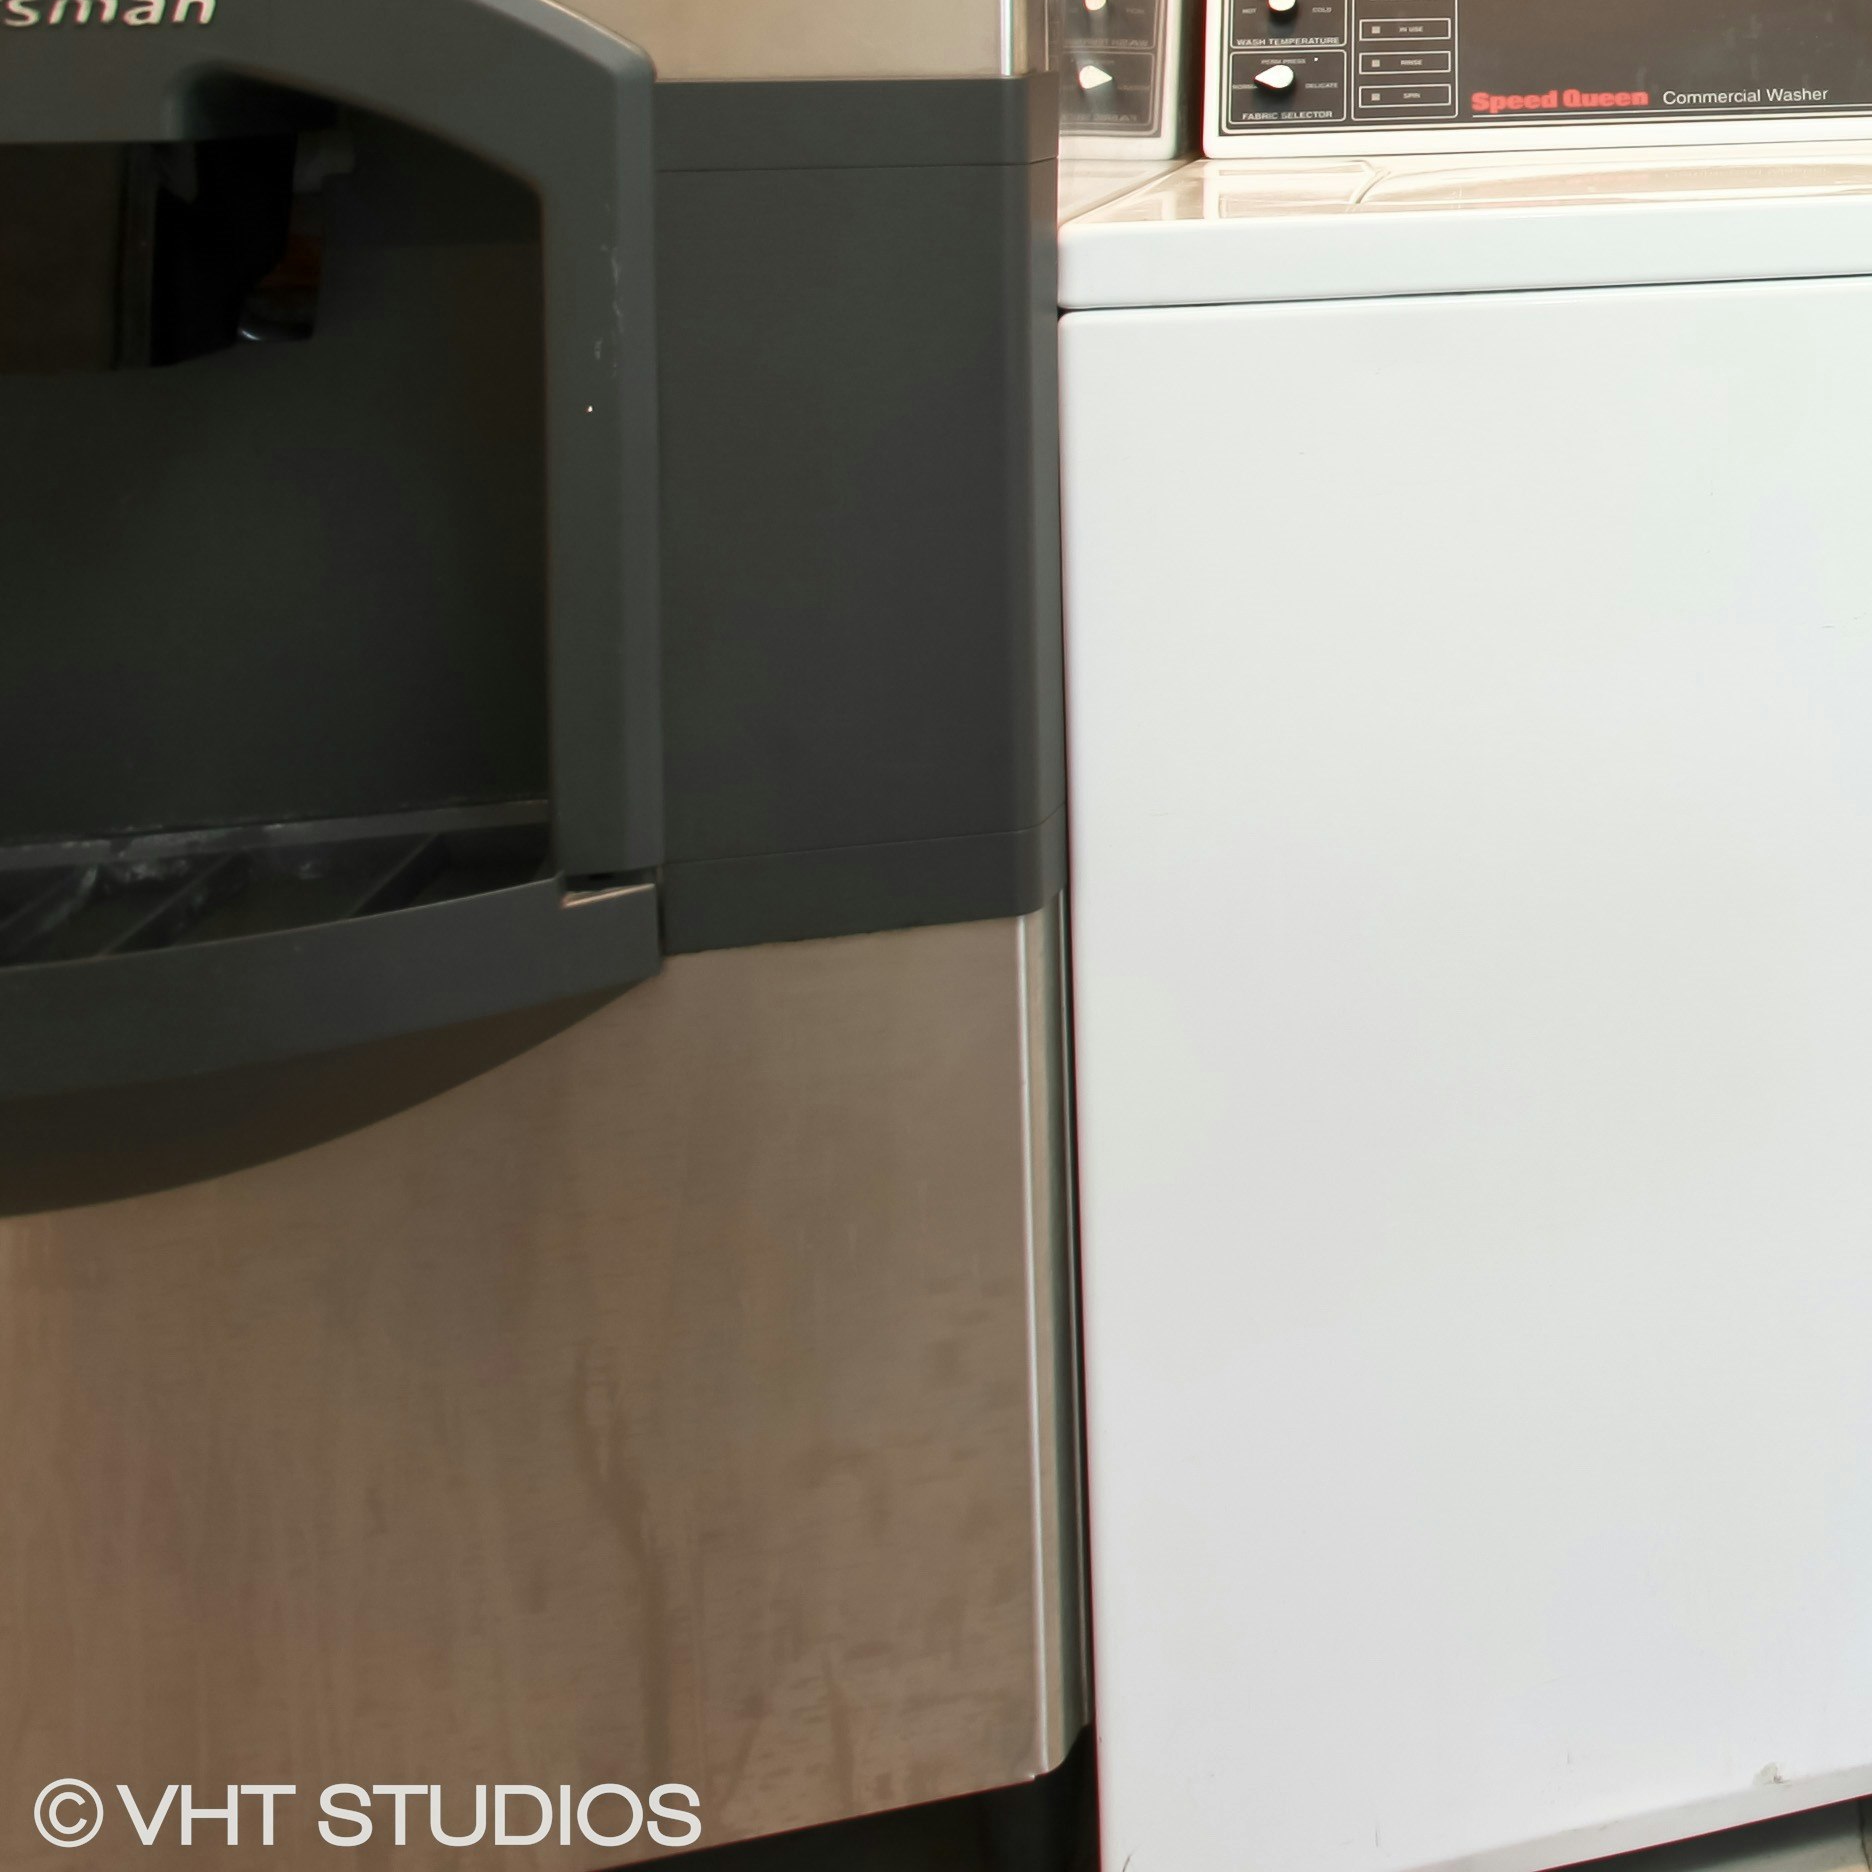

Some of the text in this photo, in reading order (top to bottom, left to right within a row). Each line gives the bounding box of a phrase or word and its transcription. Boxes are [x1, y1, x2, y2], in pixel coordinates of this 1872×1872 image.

[1237, 36, 1340, 46] WASH TEMPERATURE
[1471, 86, 1828, 114] Speed Queen Commercial Washer
[1242, 111, 1333, 120] FABRIC SELECTOR
